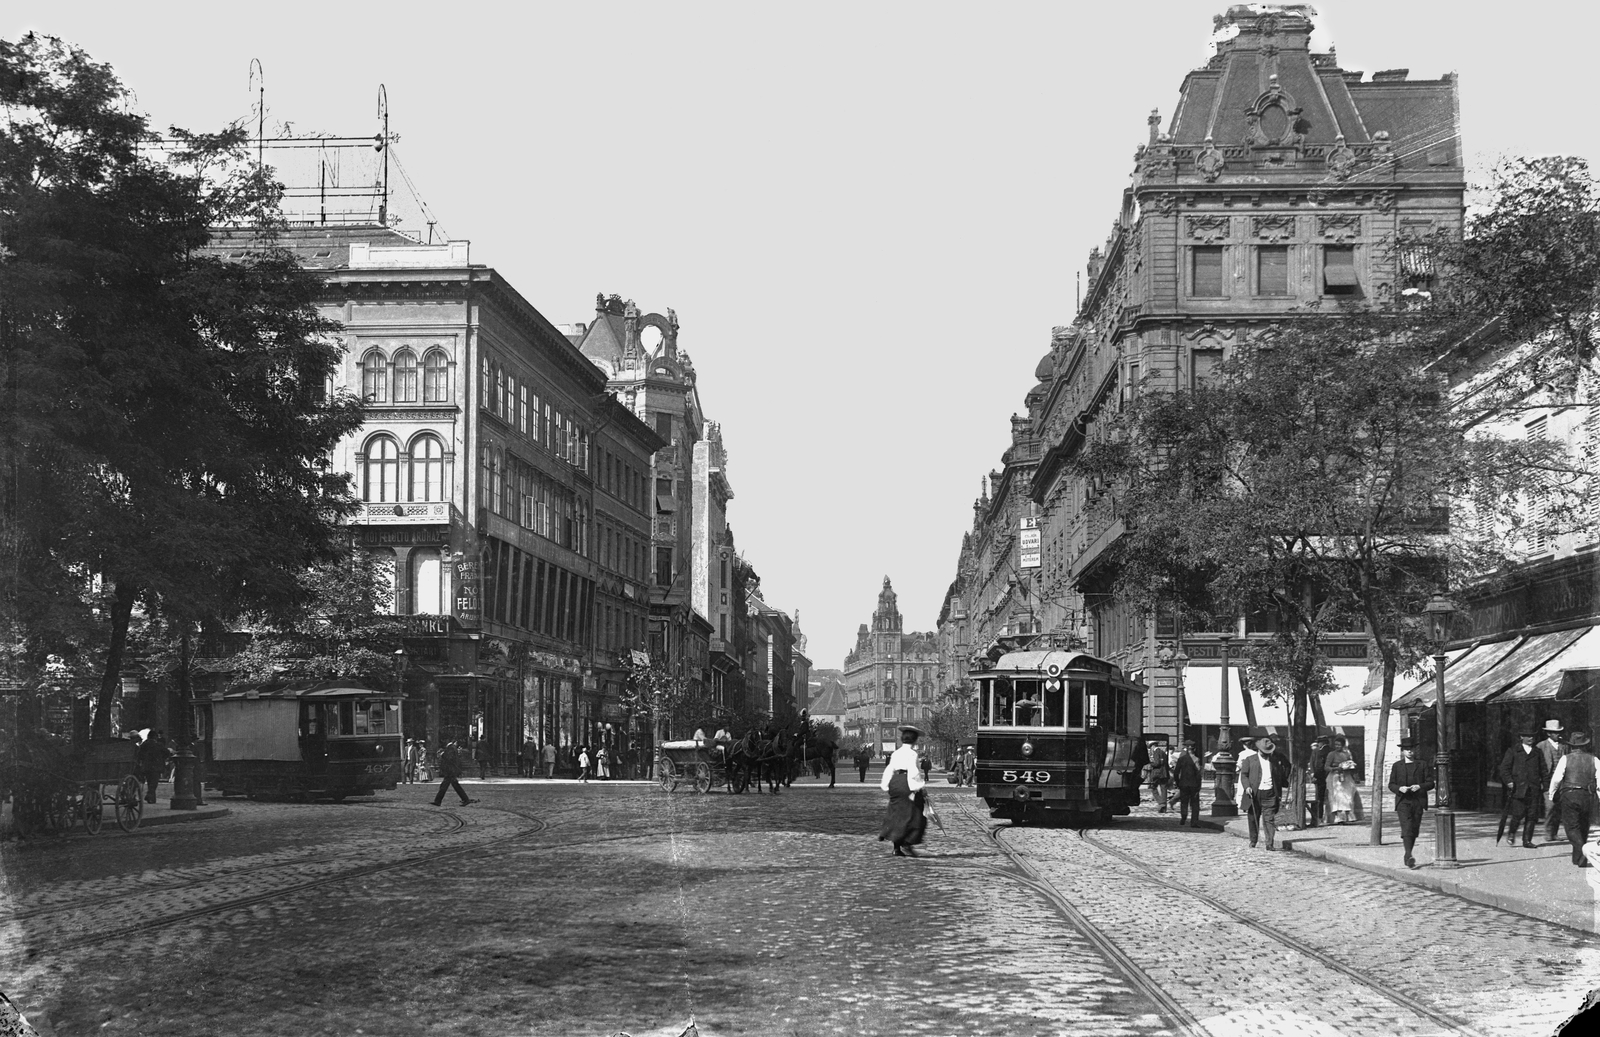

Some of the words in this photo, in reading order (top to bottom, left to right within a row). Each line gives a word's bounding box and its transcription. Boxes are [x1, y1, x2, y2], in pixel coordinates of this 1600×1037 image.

[1187, 646, 1214, 657] PESTI
[1337, 645, 1365, 657] BANK
[364, 763, 394, 774] 467
[1002, 770, 1051, 783] 549
